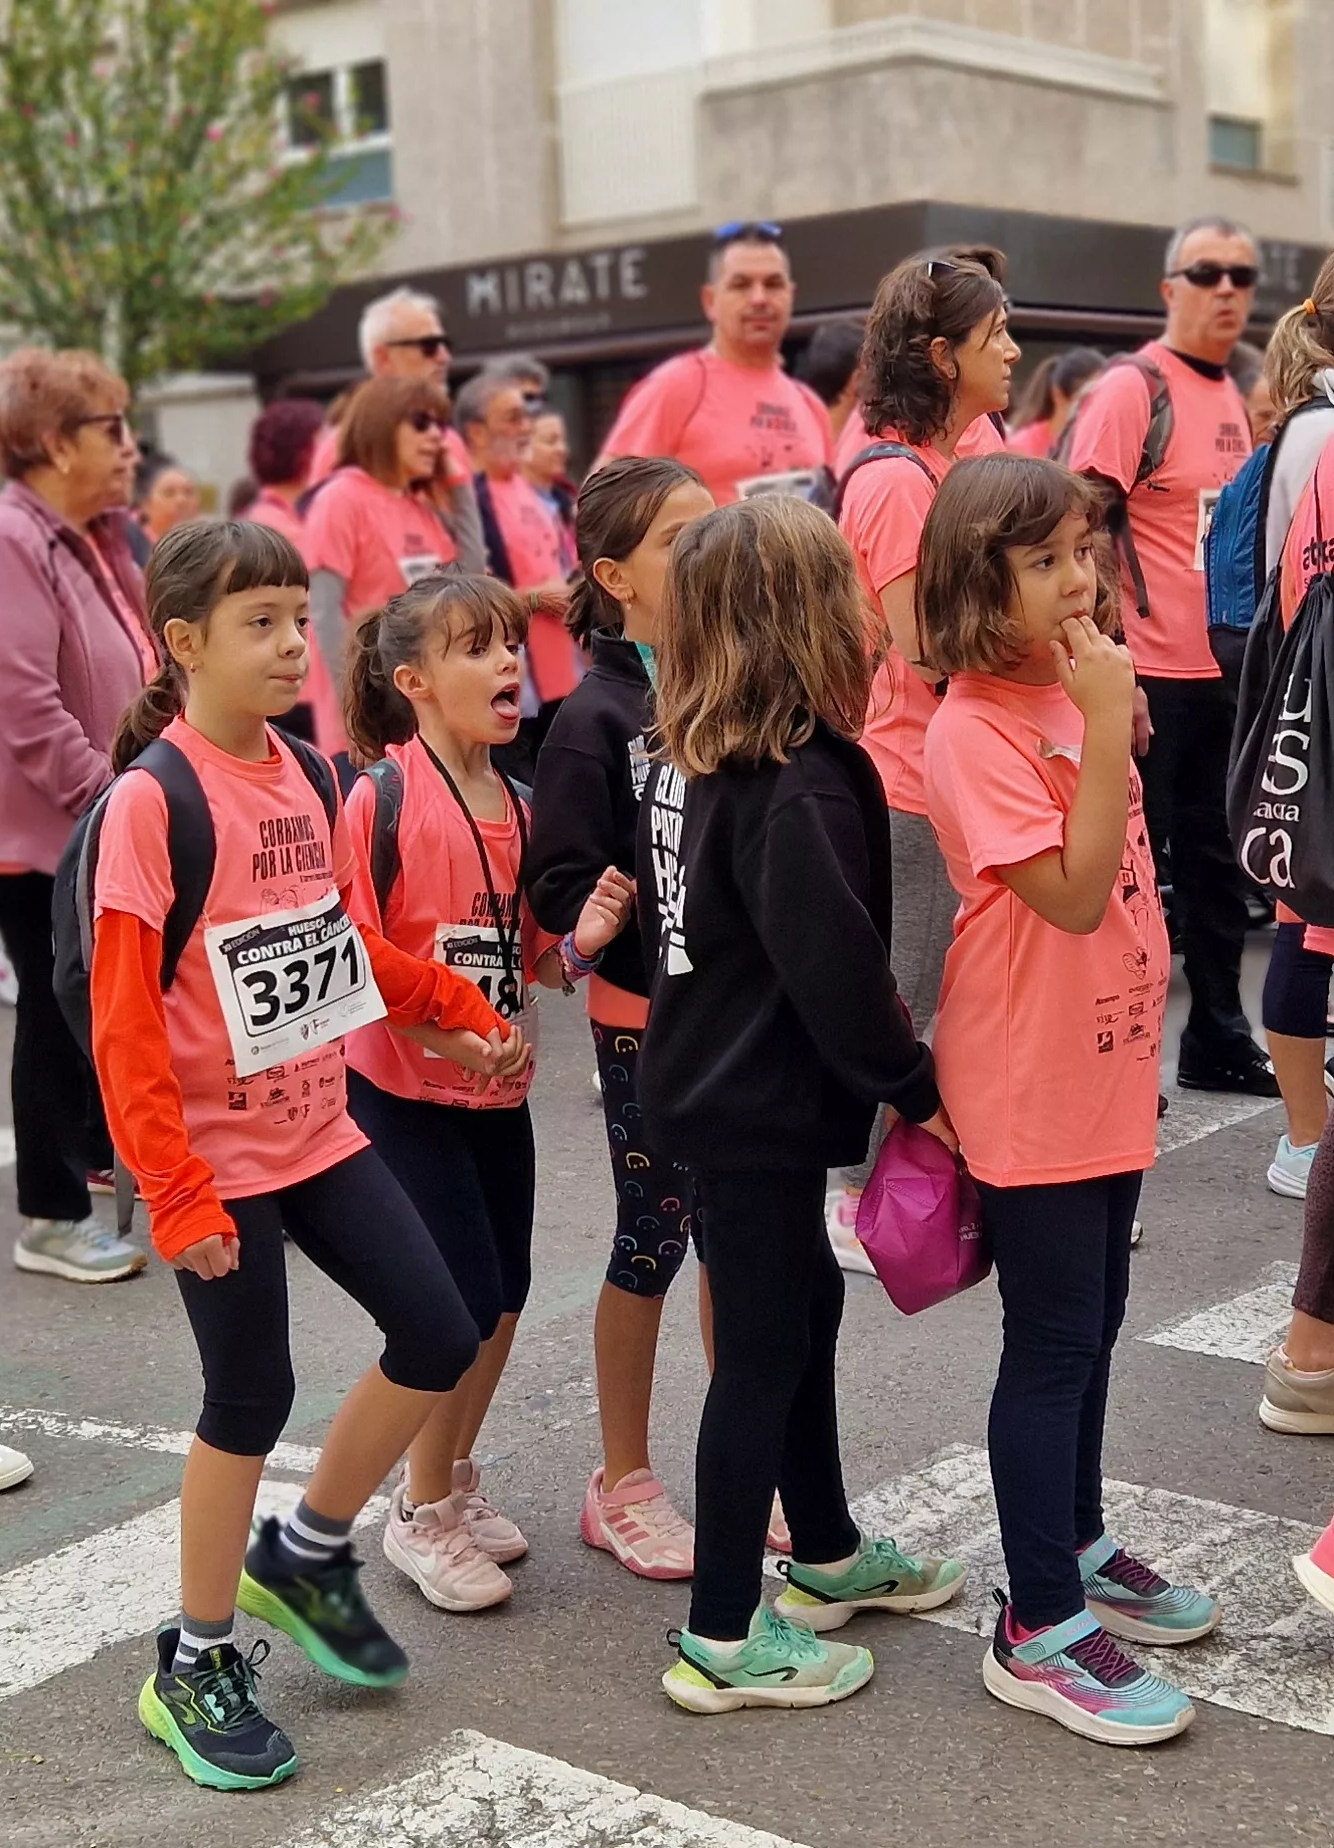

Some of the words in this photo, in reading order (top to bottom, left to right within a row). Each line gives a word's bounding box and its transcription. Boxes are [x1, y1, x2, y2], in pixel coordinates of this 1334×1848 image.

[466, 248, 648, 319] MIRATE
[259, 814, 315, 849] CORRAMOS
[252, 848, 277, 883] POR
[279, 846, 294, 875] LA
[295, 841, 327, 872] CIENCIA
[288, 917, 327, 937] HUESCA
[236, 937, 306, 965] CONTRA
[304, 932, 320, 947] EL
[453, 952, 503, 967] CONTRA
[242, 936, 358, 1026] 3371
